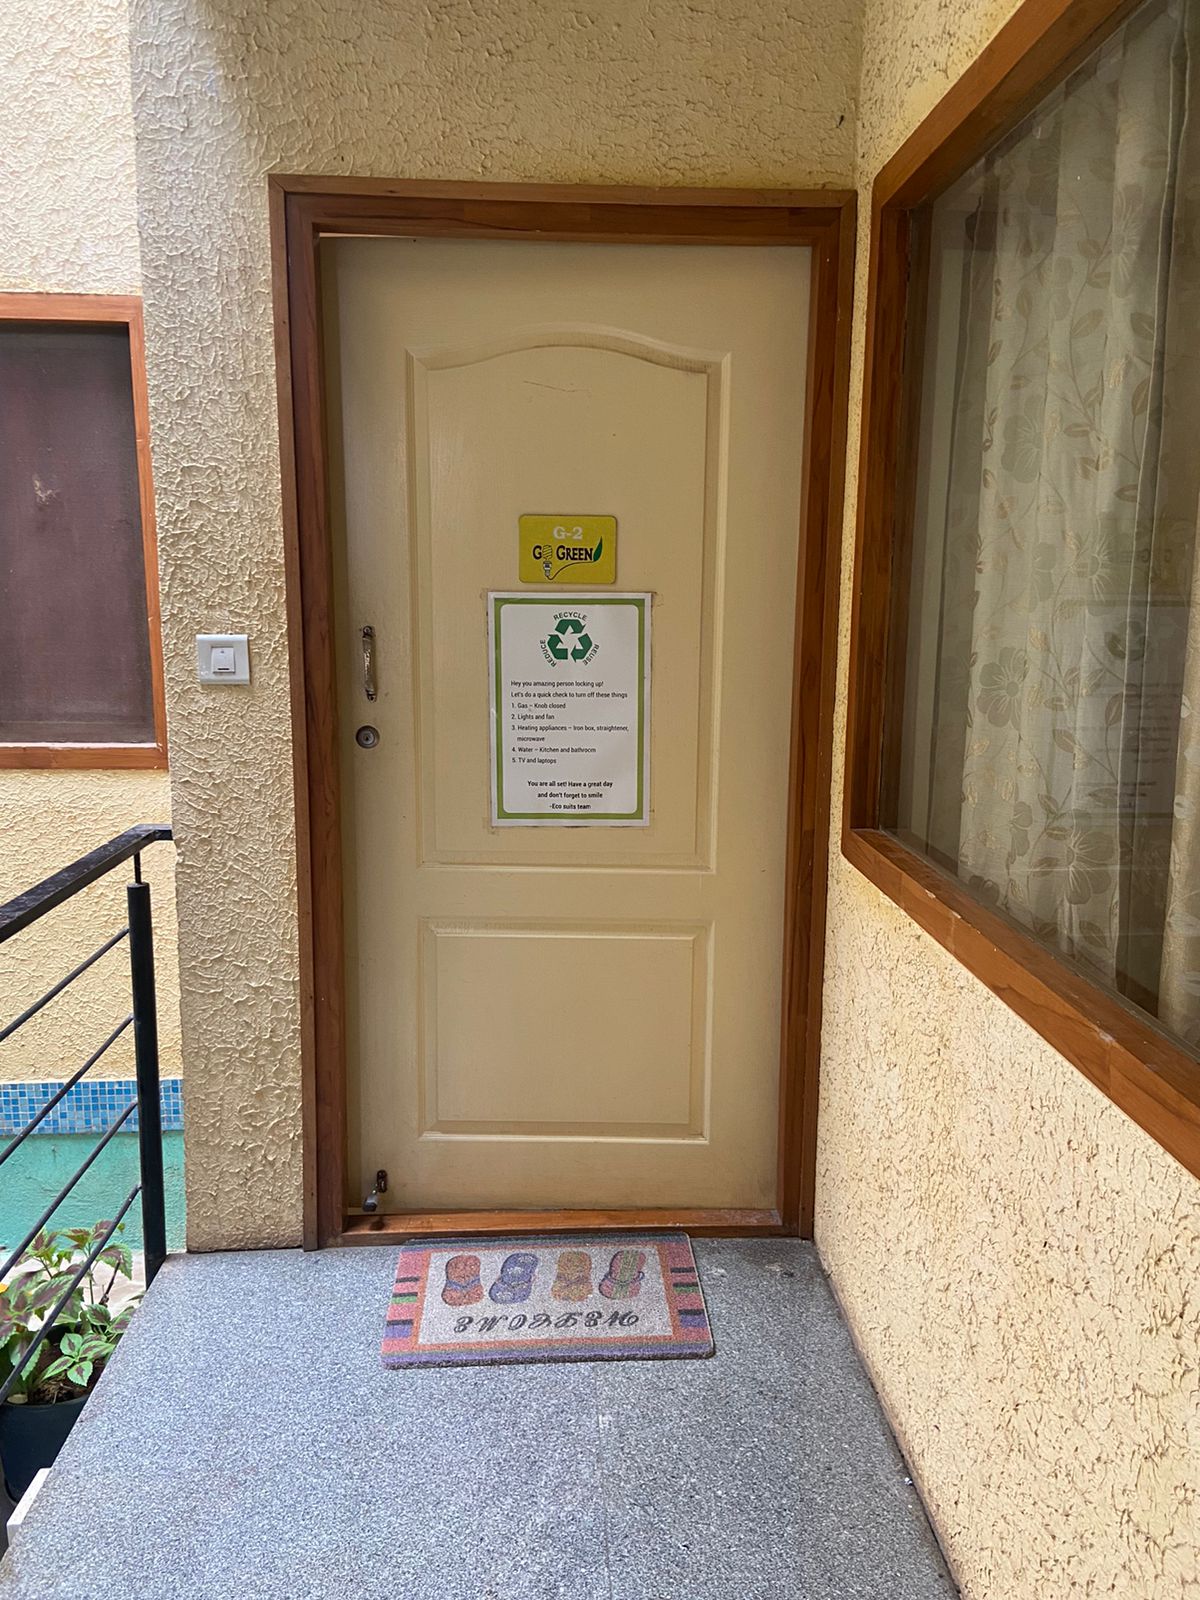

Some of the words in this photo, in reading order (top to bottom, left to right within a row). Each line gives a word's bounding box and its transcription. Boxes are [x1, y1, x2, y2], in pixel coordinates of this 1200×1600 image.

[553, 526, 583, 540] G-2
[556, 544, 593, 561] GREEN
[553, 611, 587, 621] RECYCLE
[540, 639, 557, 668] REDUCE
[583, 643, 600, 666] REUSE
[510, 680, 521, 688] Hey
[575, 680, 594, 688] locking
[595, 680, 604, 688] up!
[453, 1310, 640, 1334] WELCOME
